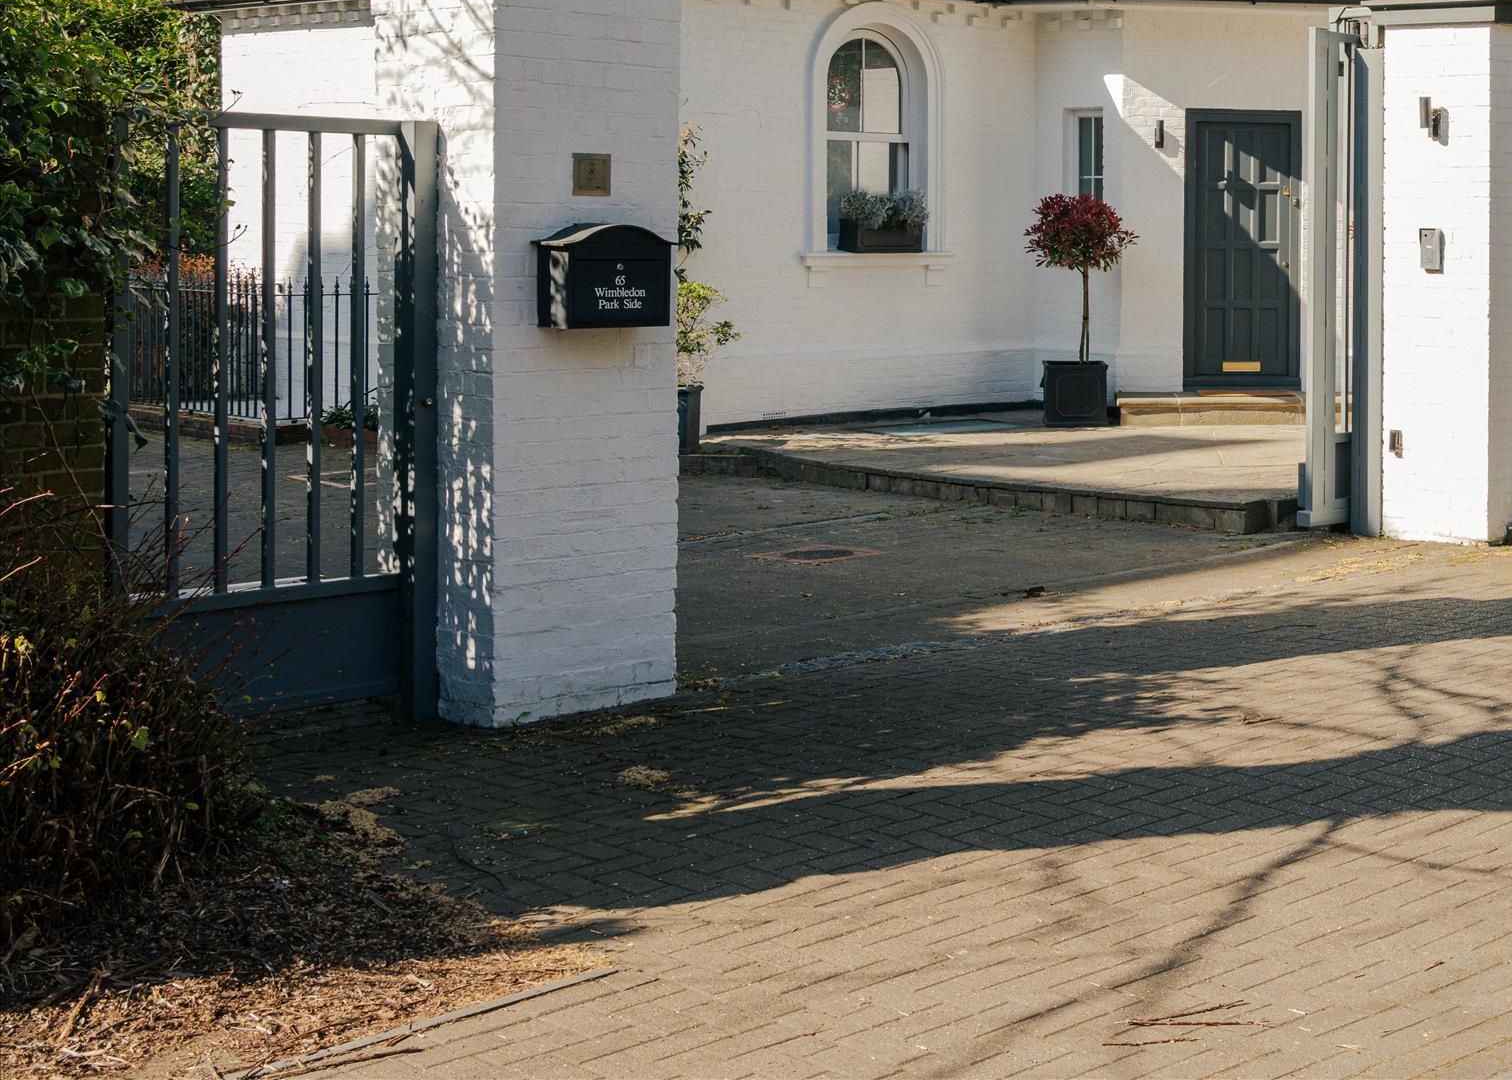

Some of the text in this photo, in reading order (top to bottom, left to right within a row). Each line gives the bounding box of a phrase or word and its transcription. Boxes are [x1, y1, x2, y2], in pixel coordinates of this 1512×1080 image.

[615, 275, 626, 286] 65
[595, 287, 646, 298] Wimbledon
[598, 299, 642, 310] Park Side
